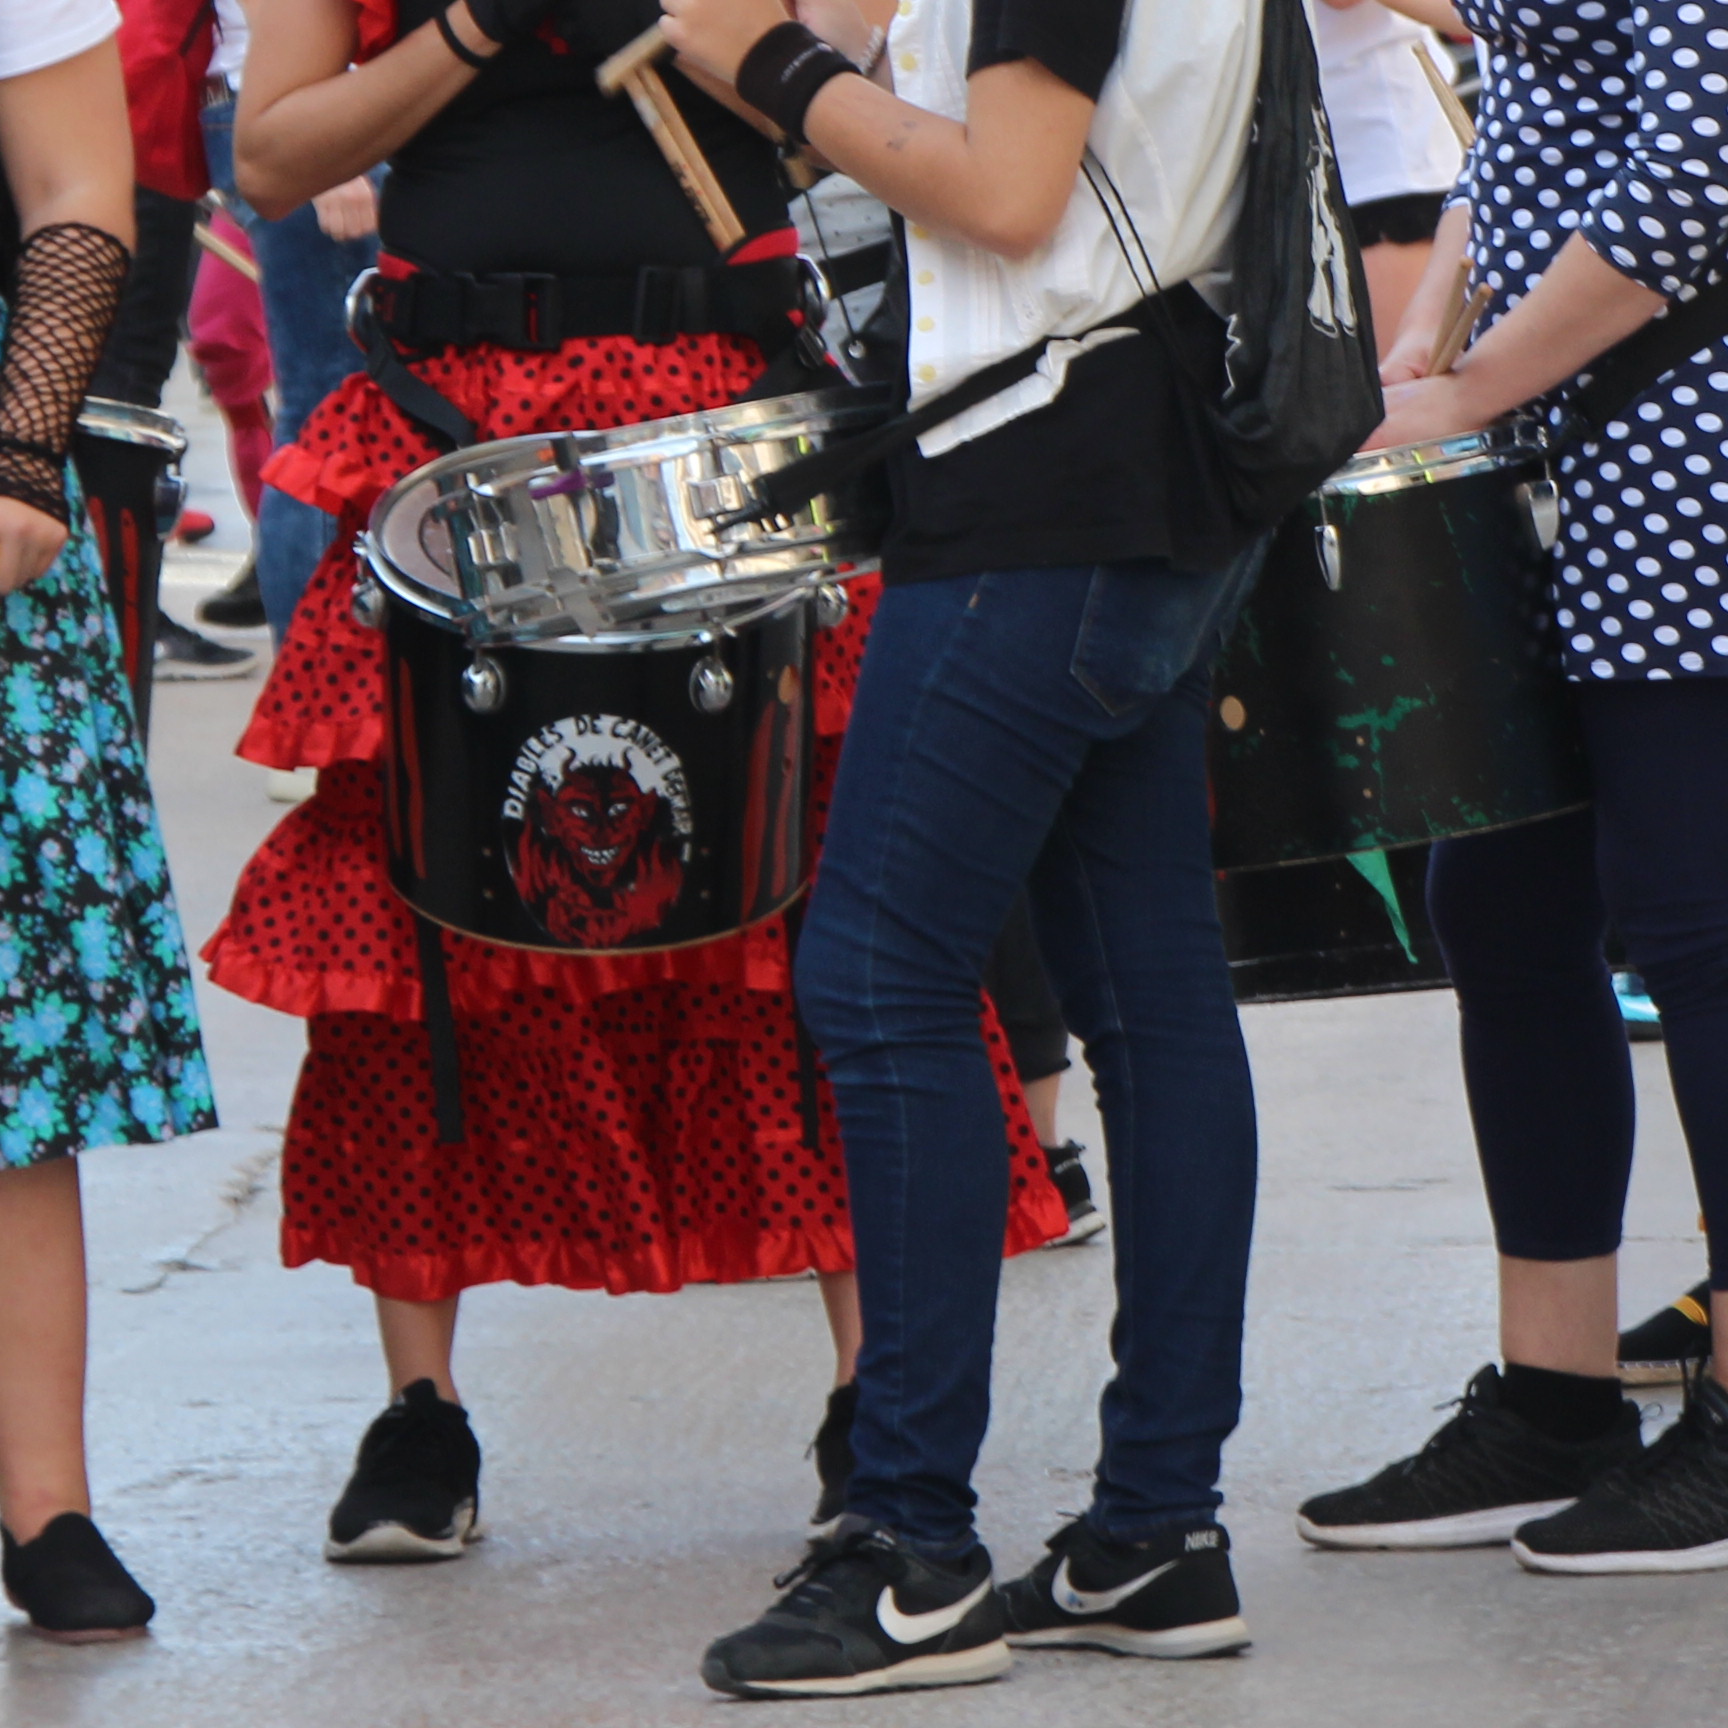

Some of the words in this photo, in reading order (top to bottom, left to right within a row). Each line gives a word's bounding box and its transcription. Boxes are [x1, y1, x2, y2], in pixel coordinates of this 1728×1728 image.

[501, 723, 565, 821] DIABLES
[573, 714, 603, 736] DE
[610, 720, 672, 766] CANET
[1184, 1529, 1219, 1553] NIKE
